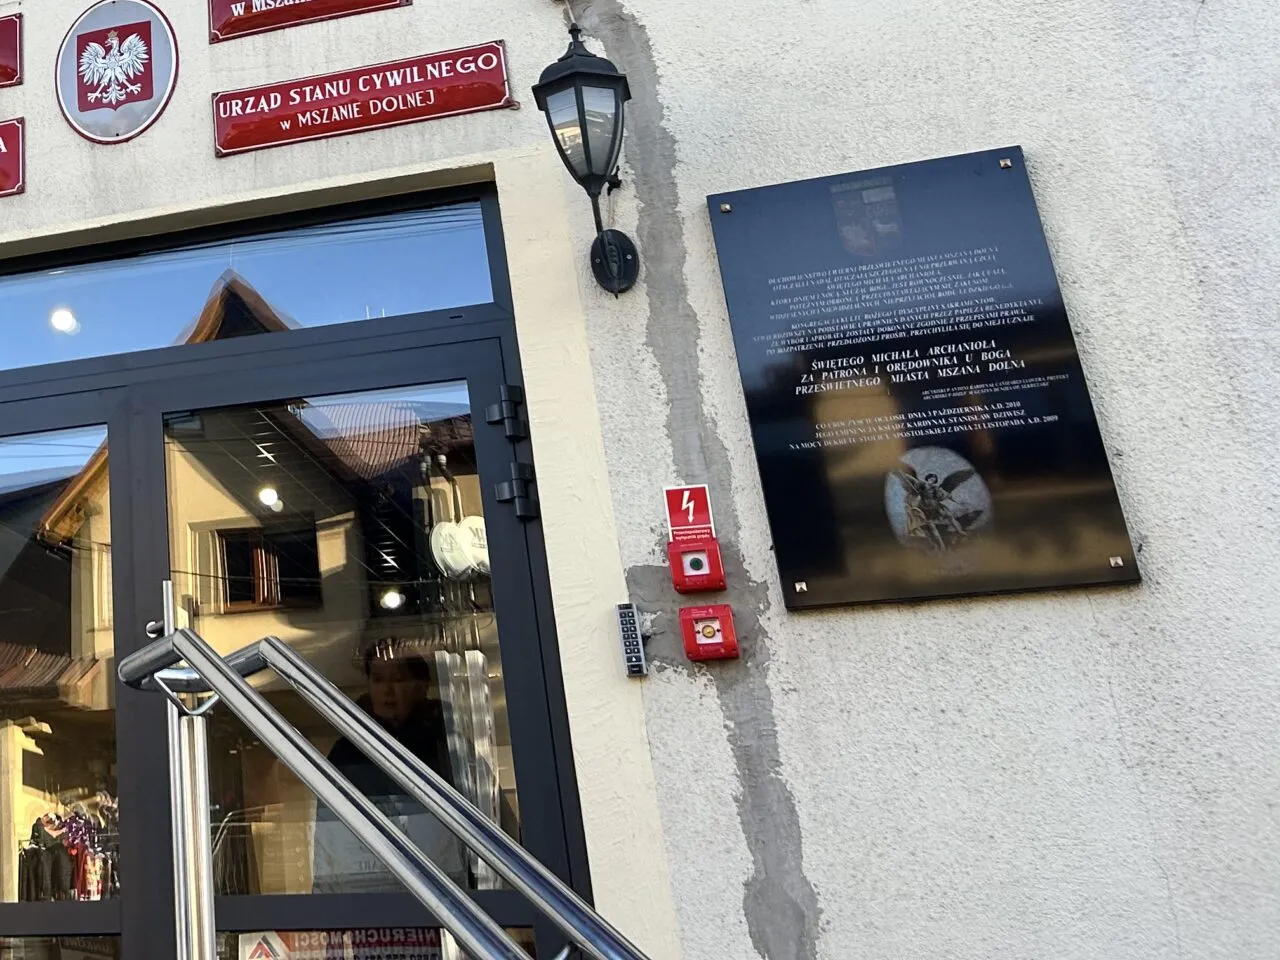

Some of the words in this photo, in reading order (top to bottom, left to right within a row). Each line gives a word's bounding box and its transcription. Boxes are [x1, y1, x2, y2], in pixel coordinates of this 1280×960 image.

[231, 2, 246, 17] w
[219, 92, 282, 119] URZĄD
[289, 79, 351, 105] STANU
[358, 52, 498, 91] CYWILNEGO
[280, 118, 291, 131] w
[298, 101, 363, 127] MSZANIE
[369, 90, 435, 115] DOLNEJ
[800, 373, 813, 382] ZA
[821, 367, 866, 380] PATRONA
[886, 356, 957, 373] ORĘDOWNIKA
[965, 354, 973, 363] U
[981, 349, 1011, 361] BOGA
[811, 354, 864, 371] ŚWIĘTEGO
[871, 349, 919, 362] MICHAŁA
[926, 340, 995, 356] ARCHANIOŁA
[794, 376, 881, 395] PRZEŚWIETNEGO
[890, 371, 929, 383] MIASTA
[936, 365, 979, 378] MSZANA
[988, 360, 1025, 372] DOLNA
